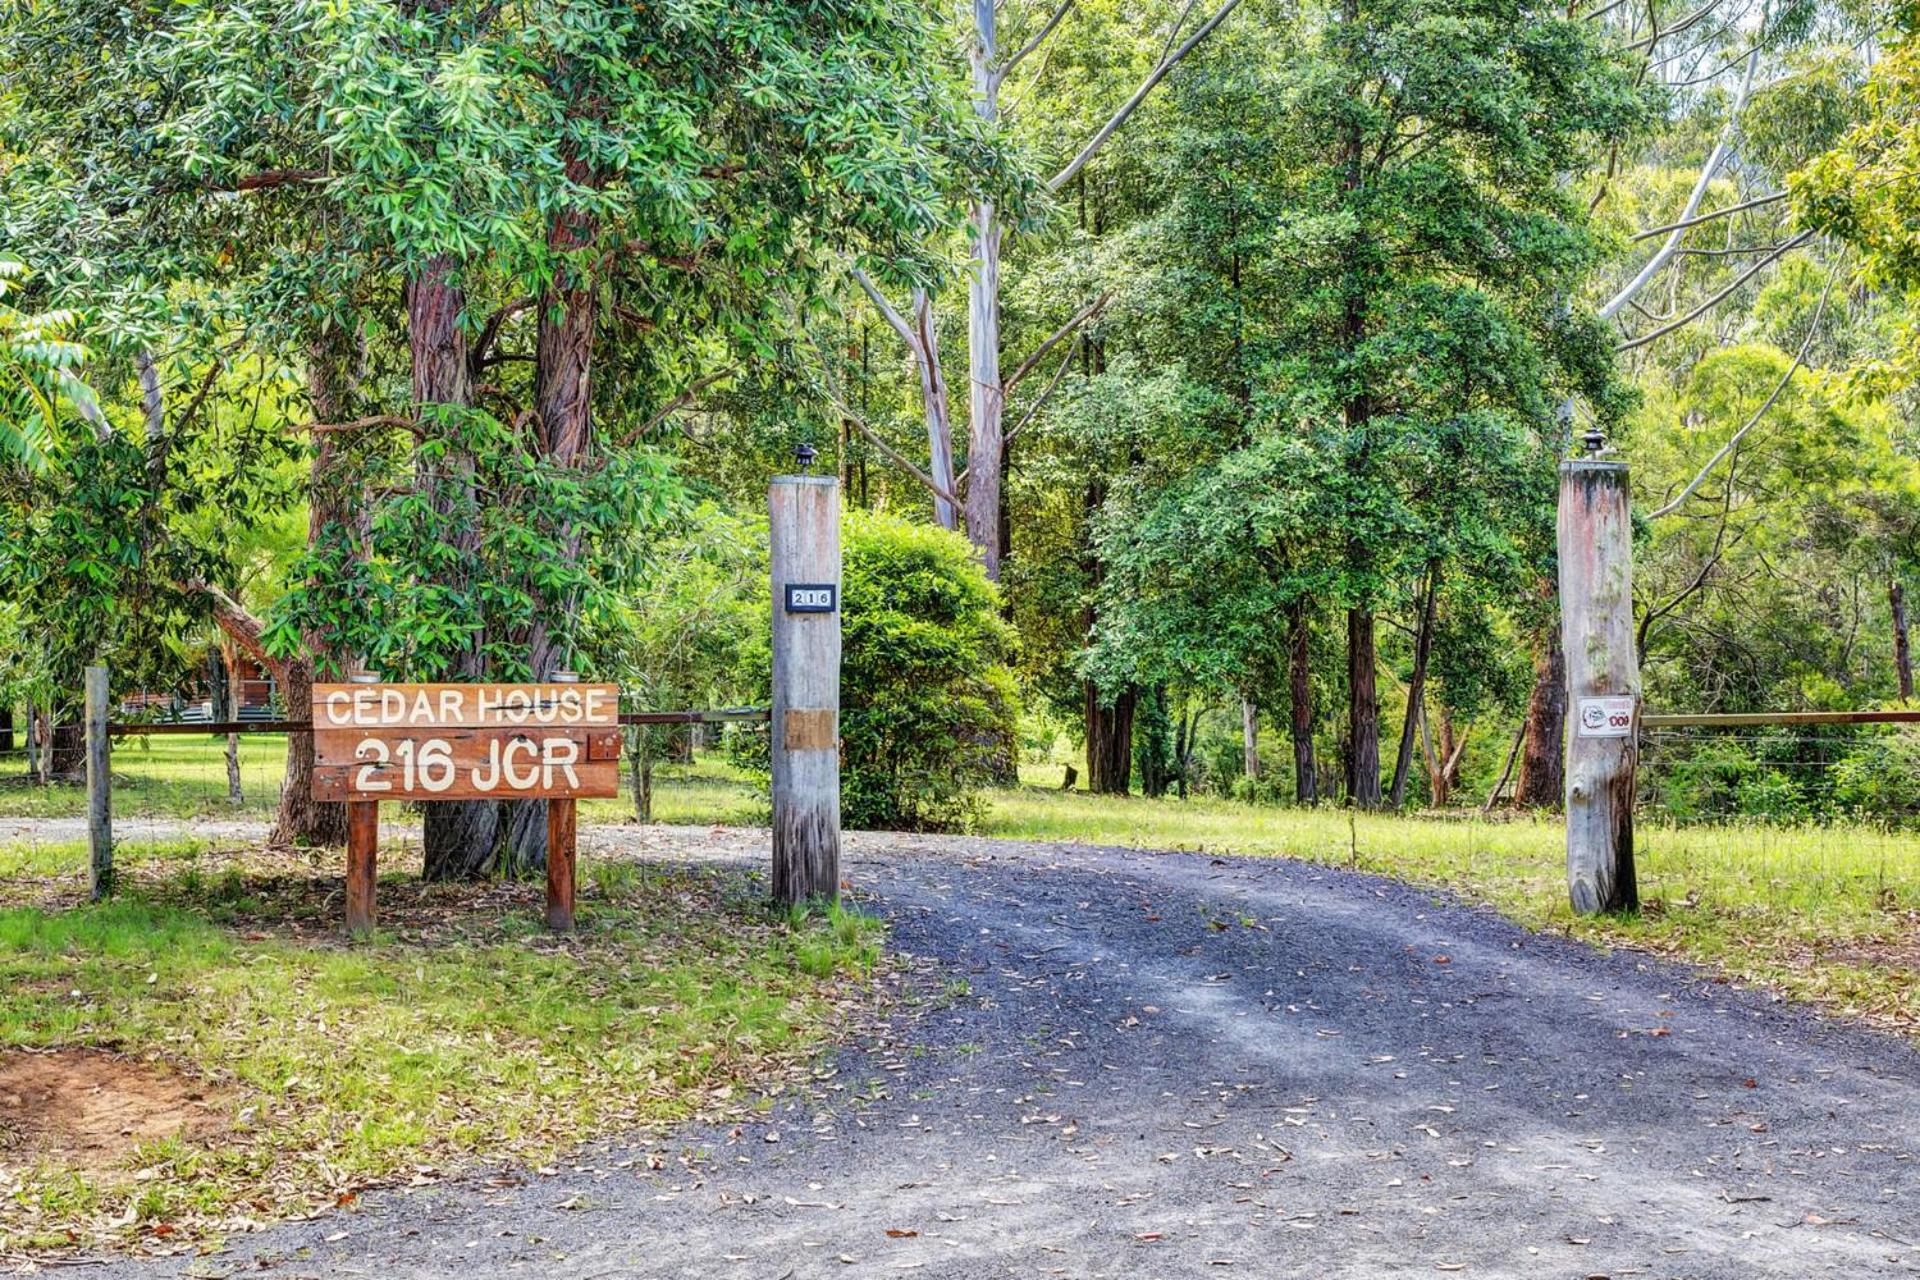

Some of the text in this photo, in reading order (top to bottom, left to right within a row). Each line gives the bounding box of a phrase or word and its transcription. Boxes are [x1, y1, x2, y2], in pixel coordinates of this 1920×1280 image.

[795, 593, 828, 604] 216
[326, 688, 609, 725] CEDAR HOUSE
[355, 737, 580, 793] 216 JCR
